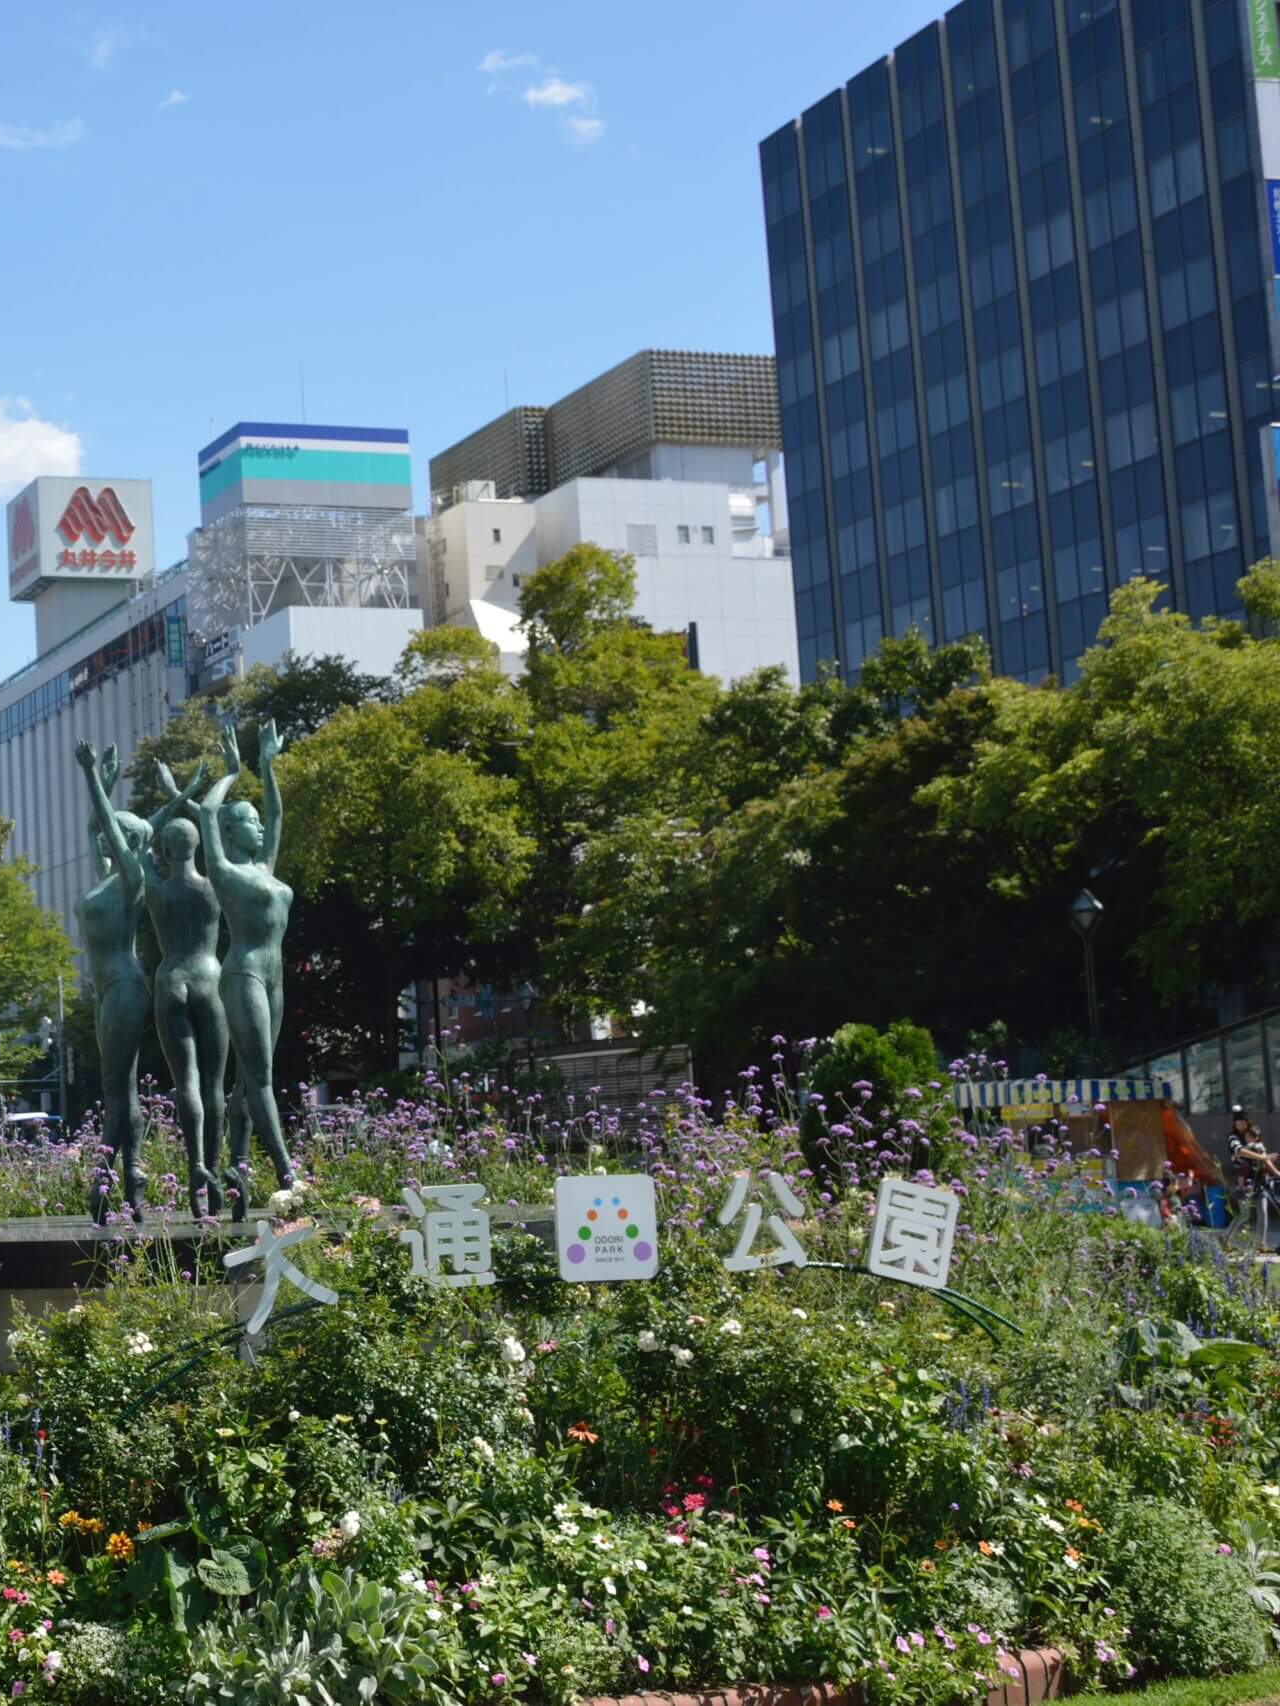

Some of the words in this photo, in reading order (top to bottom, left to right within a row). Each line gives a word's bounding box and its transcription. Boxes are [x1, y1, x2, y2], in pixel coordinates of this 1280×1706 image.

[58, 548, 136, 570] 丸井今井
[594, 1235, 624, 1245] ODORI
[594, 1245, 624, 1254] PARK
